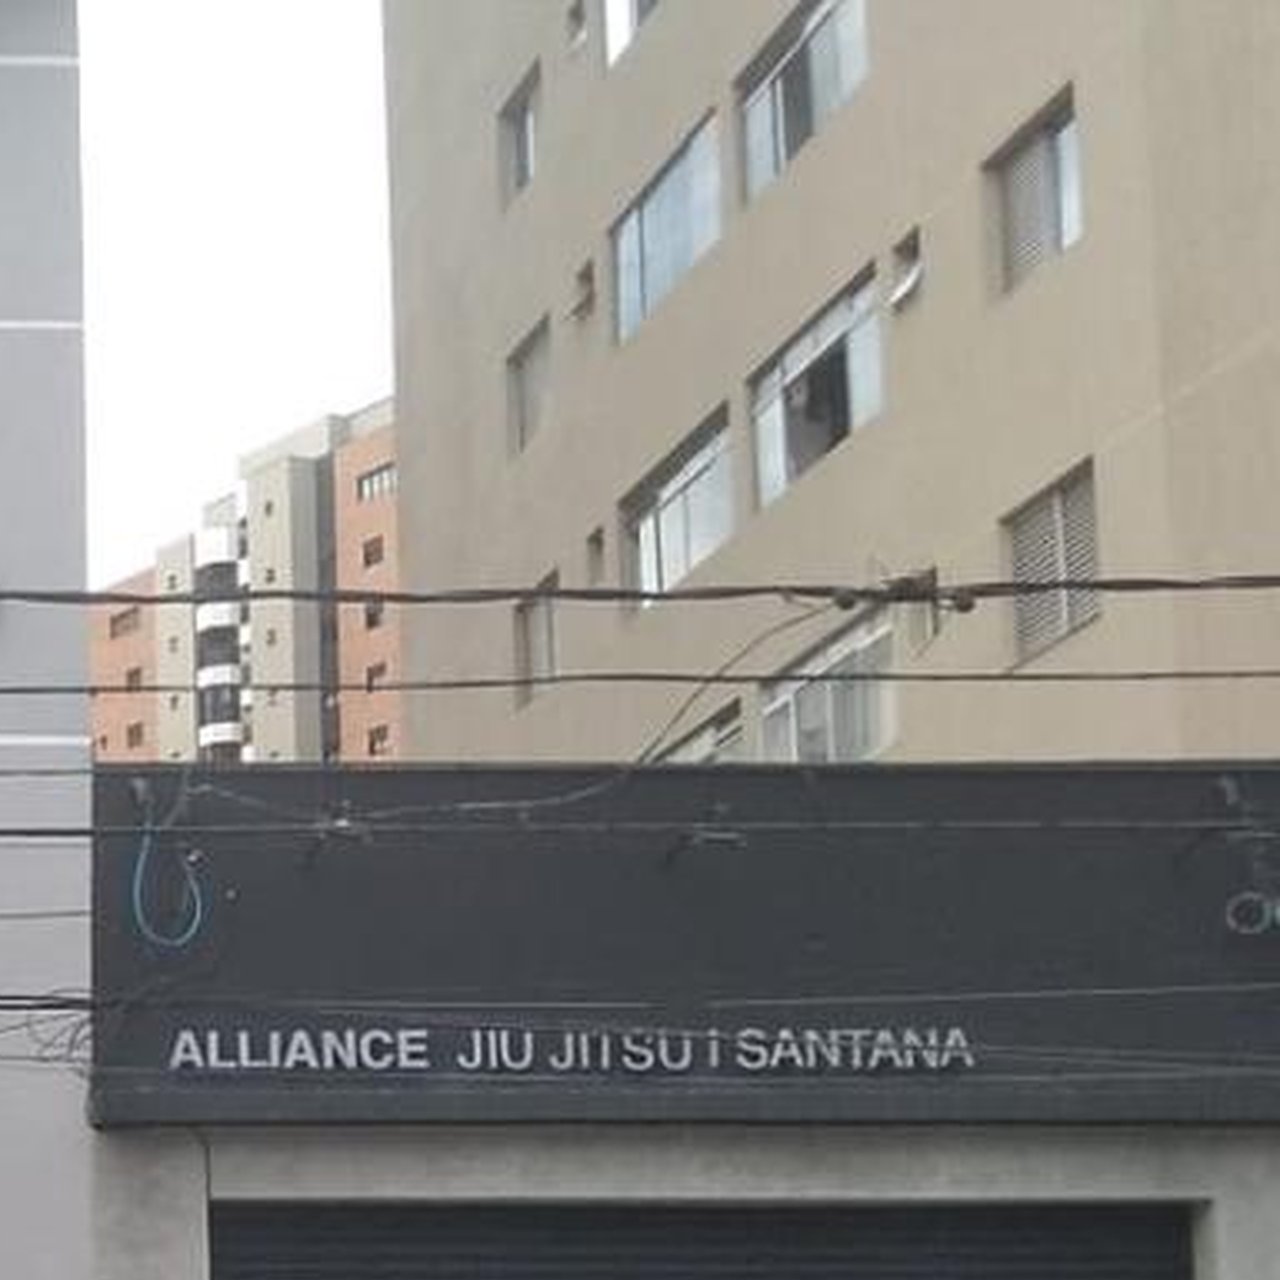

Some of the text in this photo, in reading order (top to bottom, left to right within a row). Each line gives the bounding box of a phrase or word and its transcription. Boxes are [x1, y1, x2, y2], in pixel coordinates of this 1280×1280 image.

[169, 1028, 431, 1069] ALLIANCE
[457, 1028, 534, 1069] JIU
[736, 1026, 975, 1070] SANTANA
